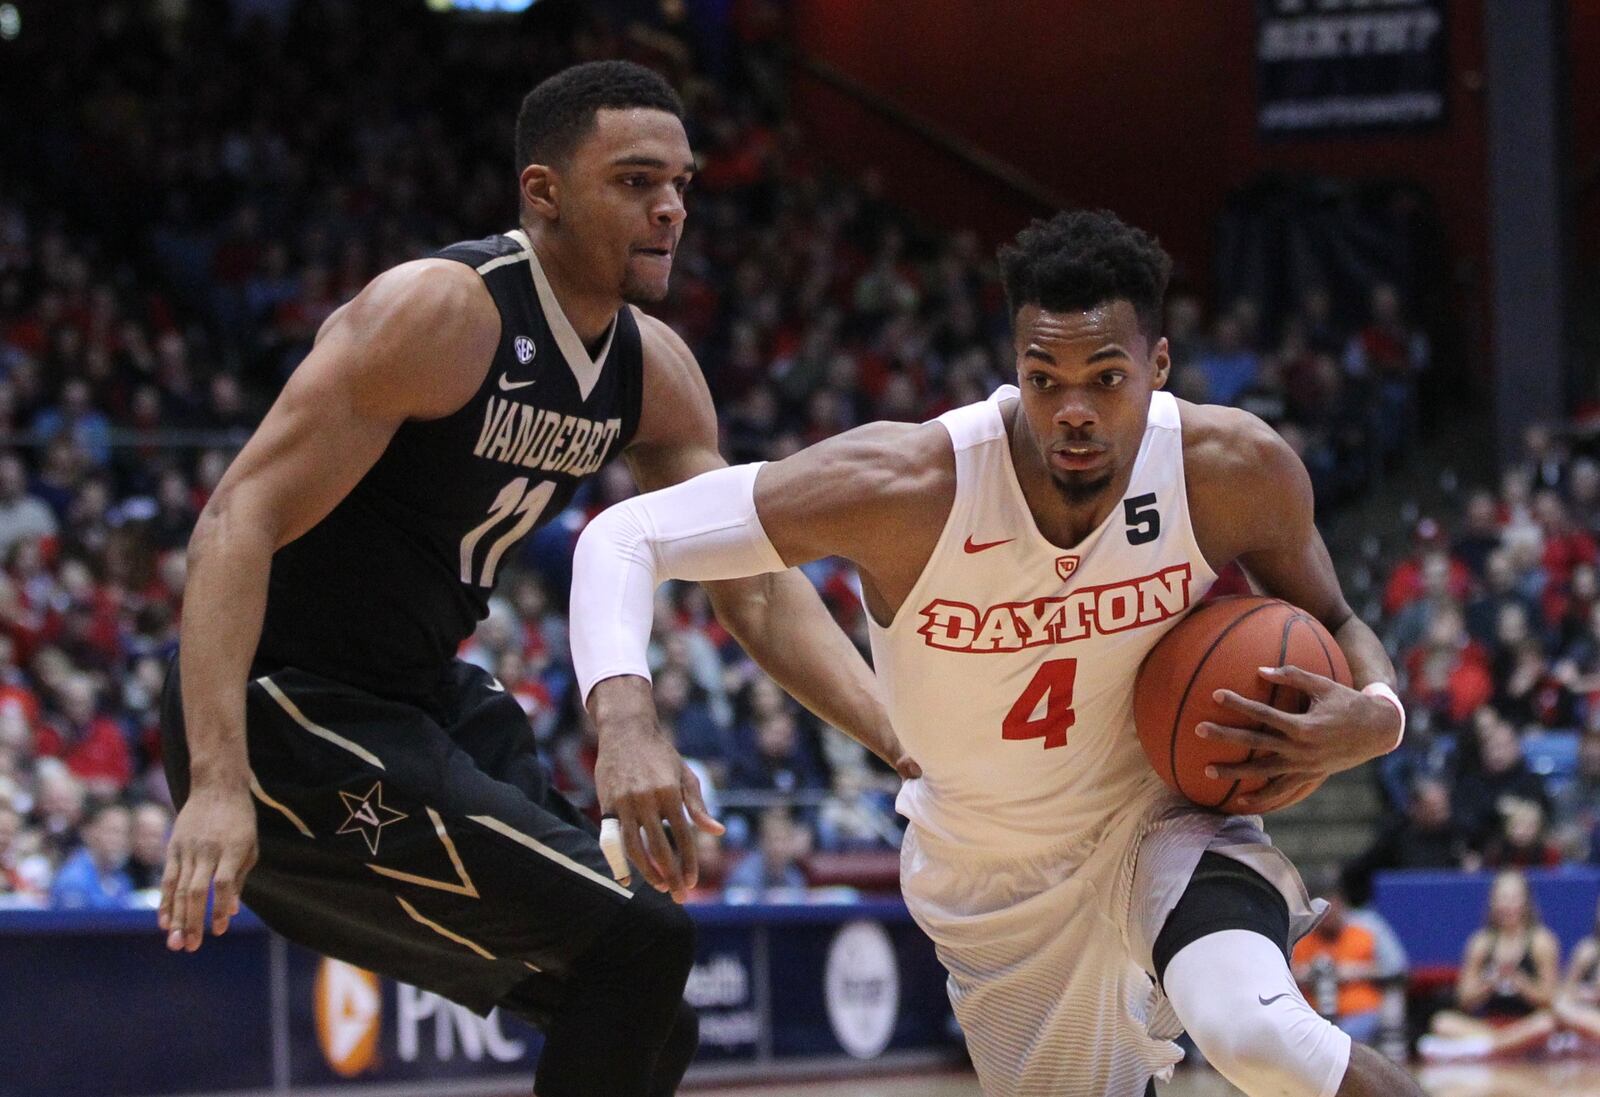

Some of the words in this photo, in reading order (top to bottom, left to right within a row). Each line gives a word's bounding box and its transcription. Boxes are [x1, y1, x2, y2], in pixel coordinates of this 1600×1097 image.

[515, 338, 534, 362] SEC
[459, 477, 557, 587] 11
[1123, 492, 1161, 546] 5
[917, 562, 1192, 653] DAYTON
[1001, 658, 1078, 750] 4
